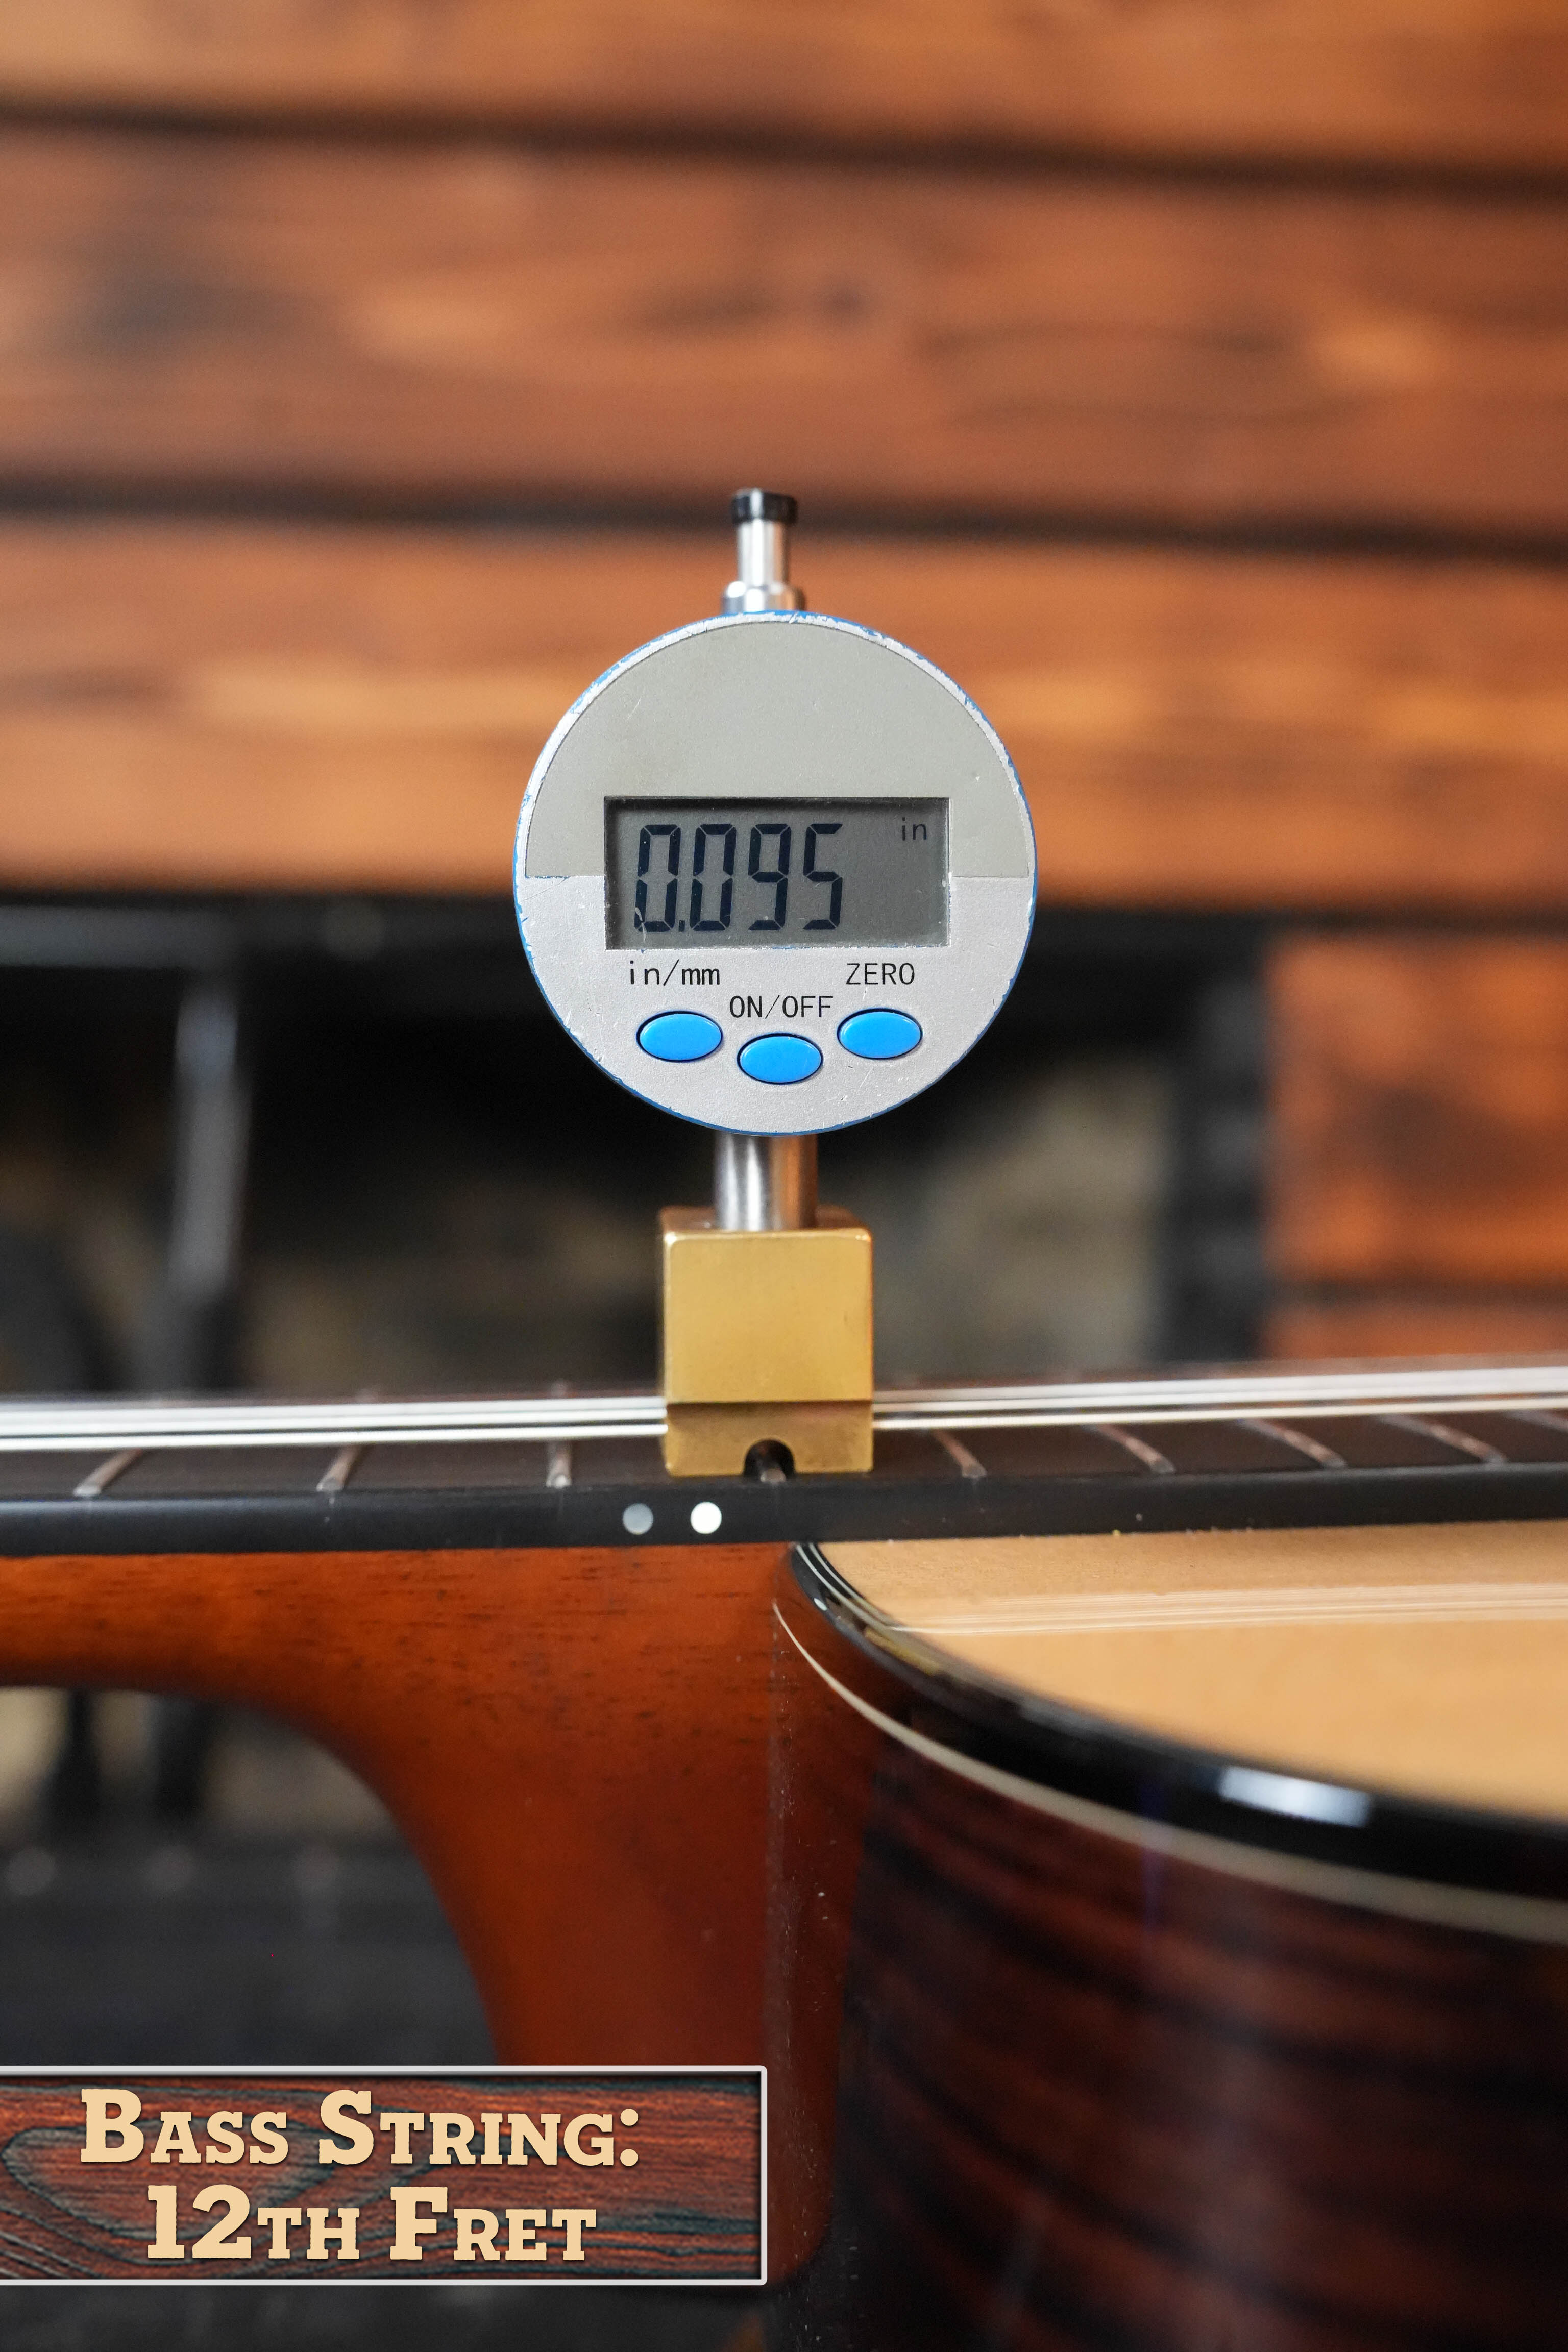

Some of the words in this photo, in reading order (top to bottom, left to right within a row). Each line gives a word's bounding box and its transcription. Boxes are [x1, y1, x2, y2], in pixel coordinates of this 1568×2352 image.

[901, 818, 928, 841] in
[634, 823, 843, 932] 0.095
[629, 959, 721, 986] in/mm
[845, 963, 916, 986] ZERO
[729, 995, 834, 1019] ON/OFF
